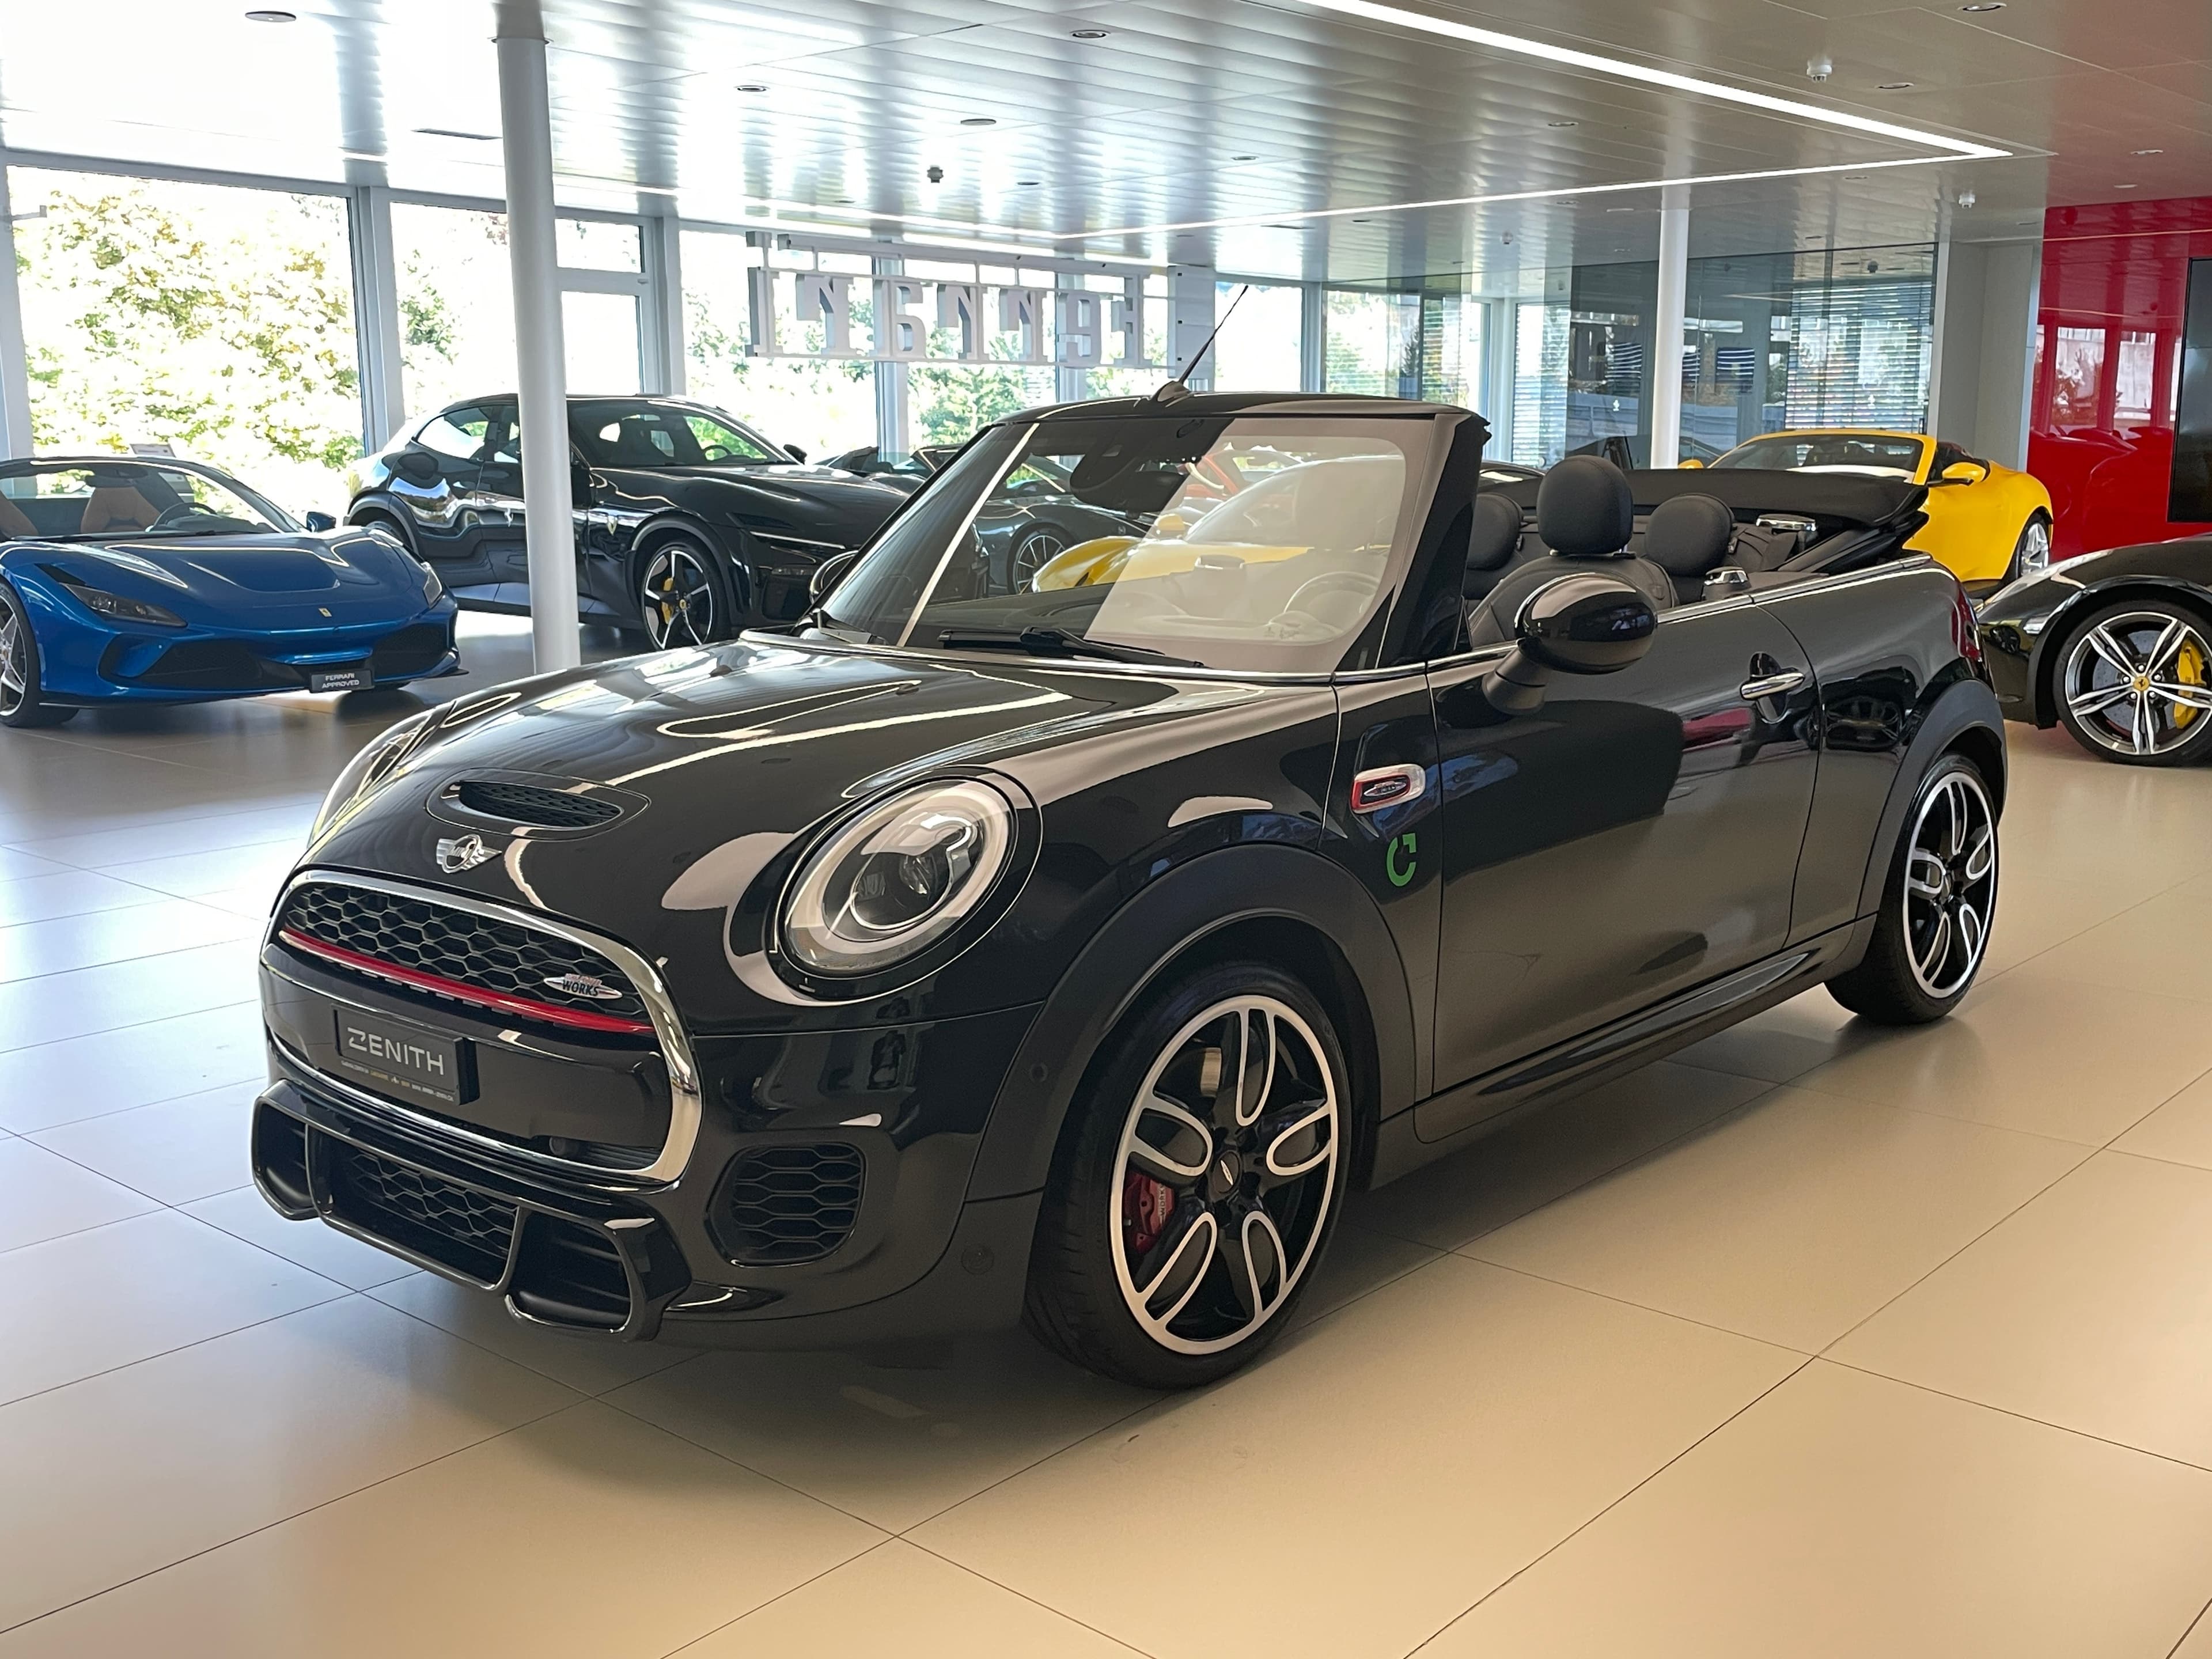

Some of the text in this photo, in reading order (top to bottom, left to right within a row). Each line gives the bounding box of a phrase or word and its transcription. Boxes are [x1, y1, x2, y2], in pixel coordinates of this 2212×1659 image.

[325, 673, 355, 681] FERRARI
[321, 680, 359, 688] APPROVED
[562, 980, 600, 997] WORKS
[347, 1027, 444, 1075] ZENITH
